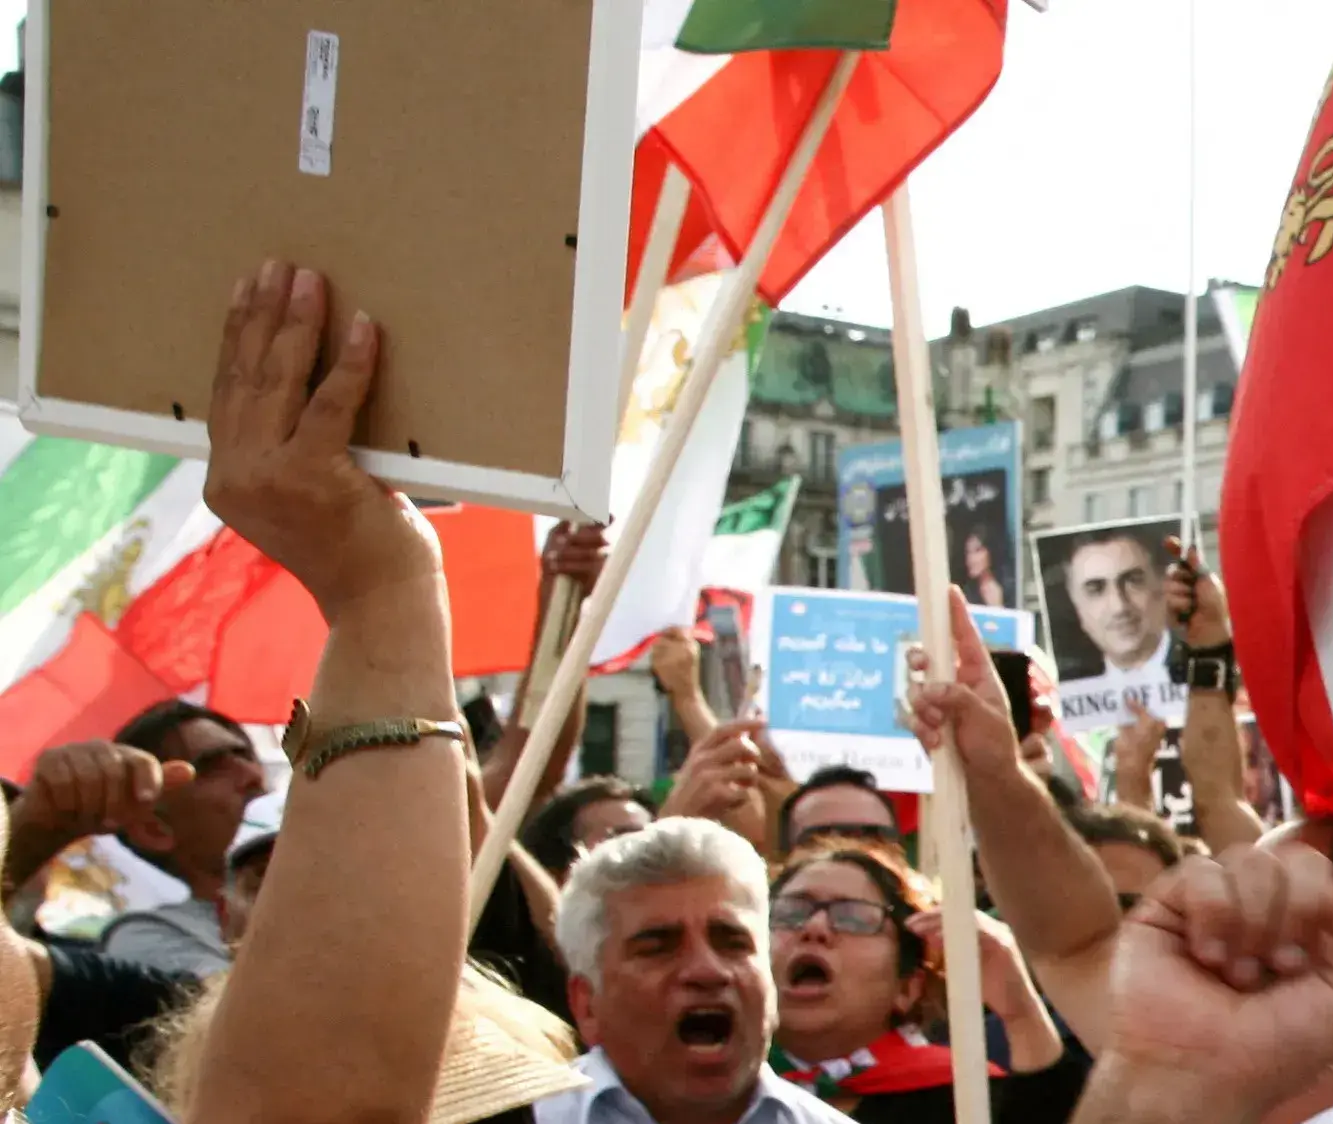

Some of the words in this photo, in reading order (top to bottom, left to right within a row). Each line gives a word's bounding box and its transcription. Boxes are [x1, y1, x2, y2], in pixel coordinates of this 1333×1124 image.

[1061, 694, 1118, 719] KING
[1122, 682, 1155, 711] OF
[1159, 681, 1188, 703] IR
